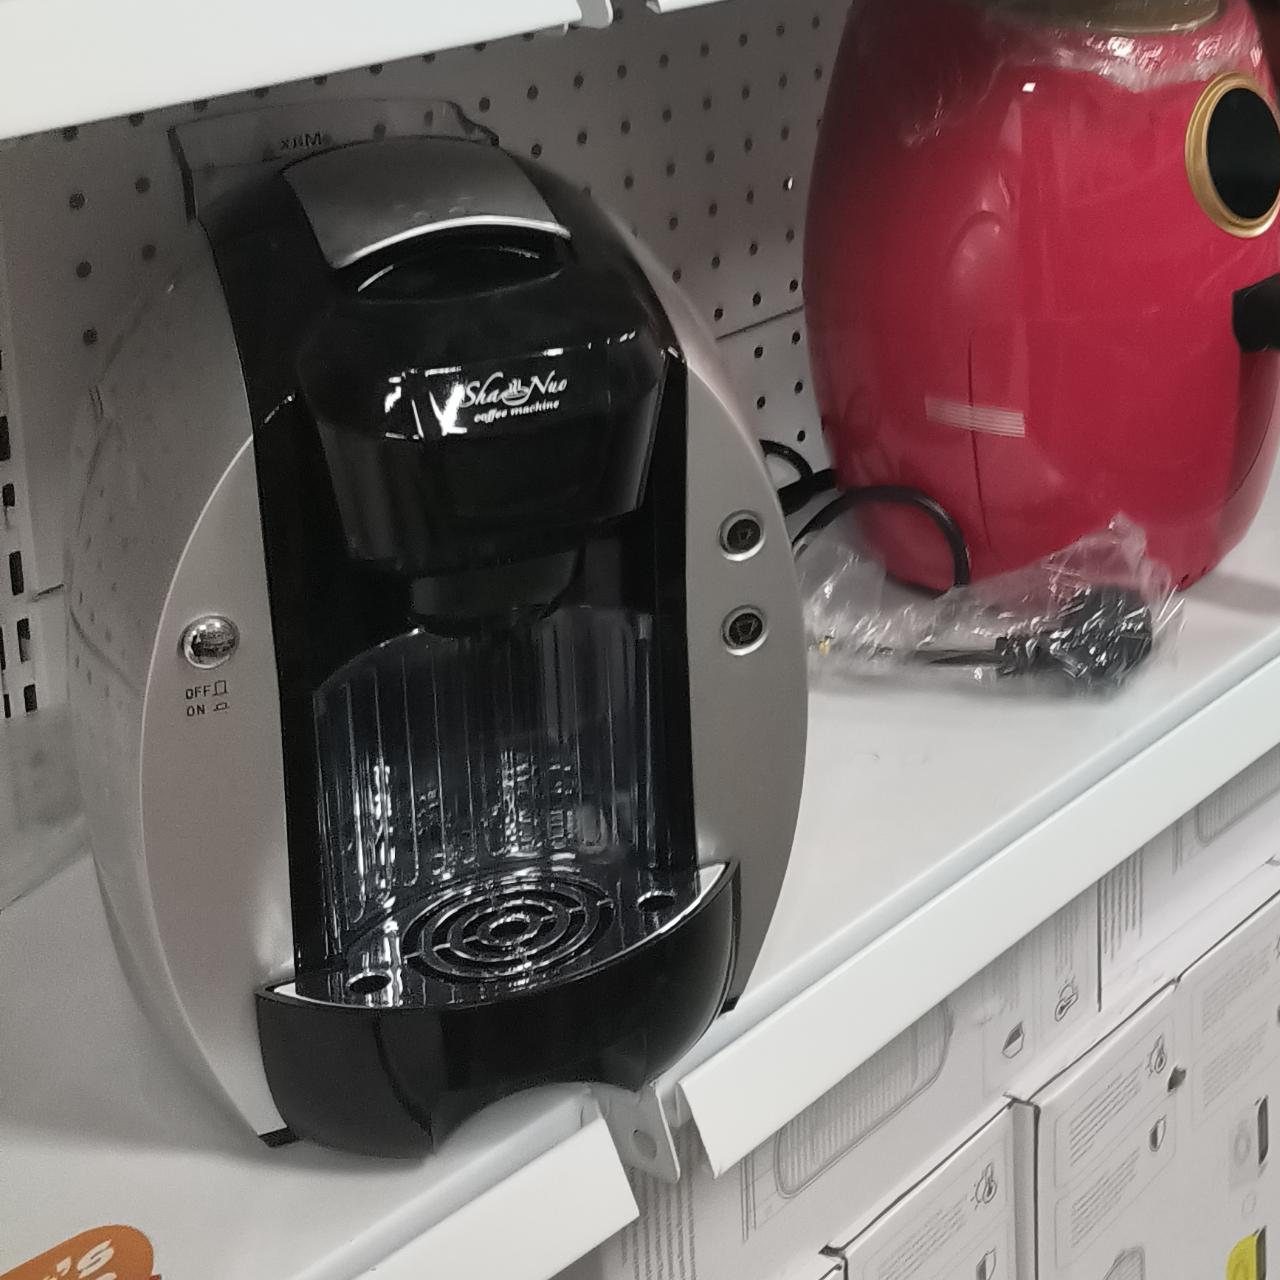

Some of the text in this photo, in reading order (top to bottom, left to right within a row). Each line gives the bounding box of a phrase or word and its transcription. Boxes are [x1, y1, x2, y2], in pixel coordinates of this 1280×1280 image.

[474, 399, 560, 423] coffee machine
[185, 684, 212, 700] OFF
[186, 704, 206, 717] ON
